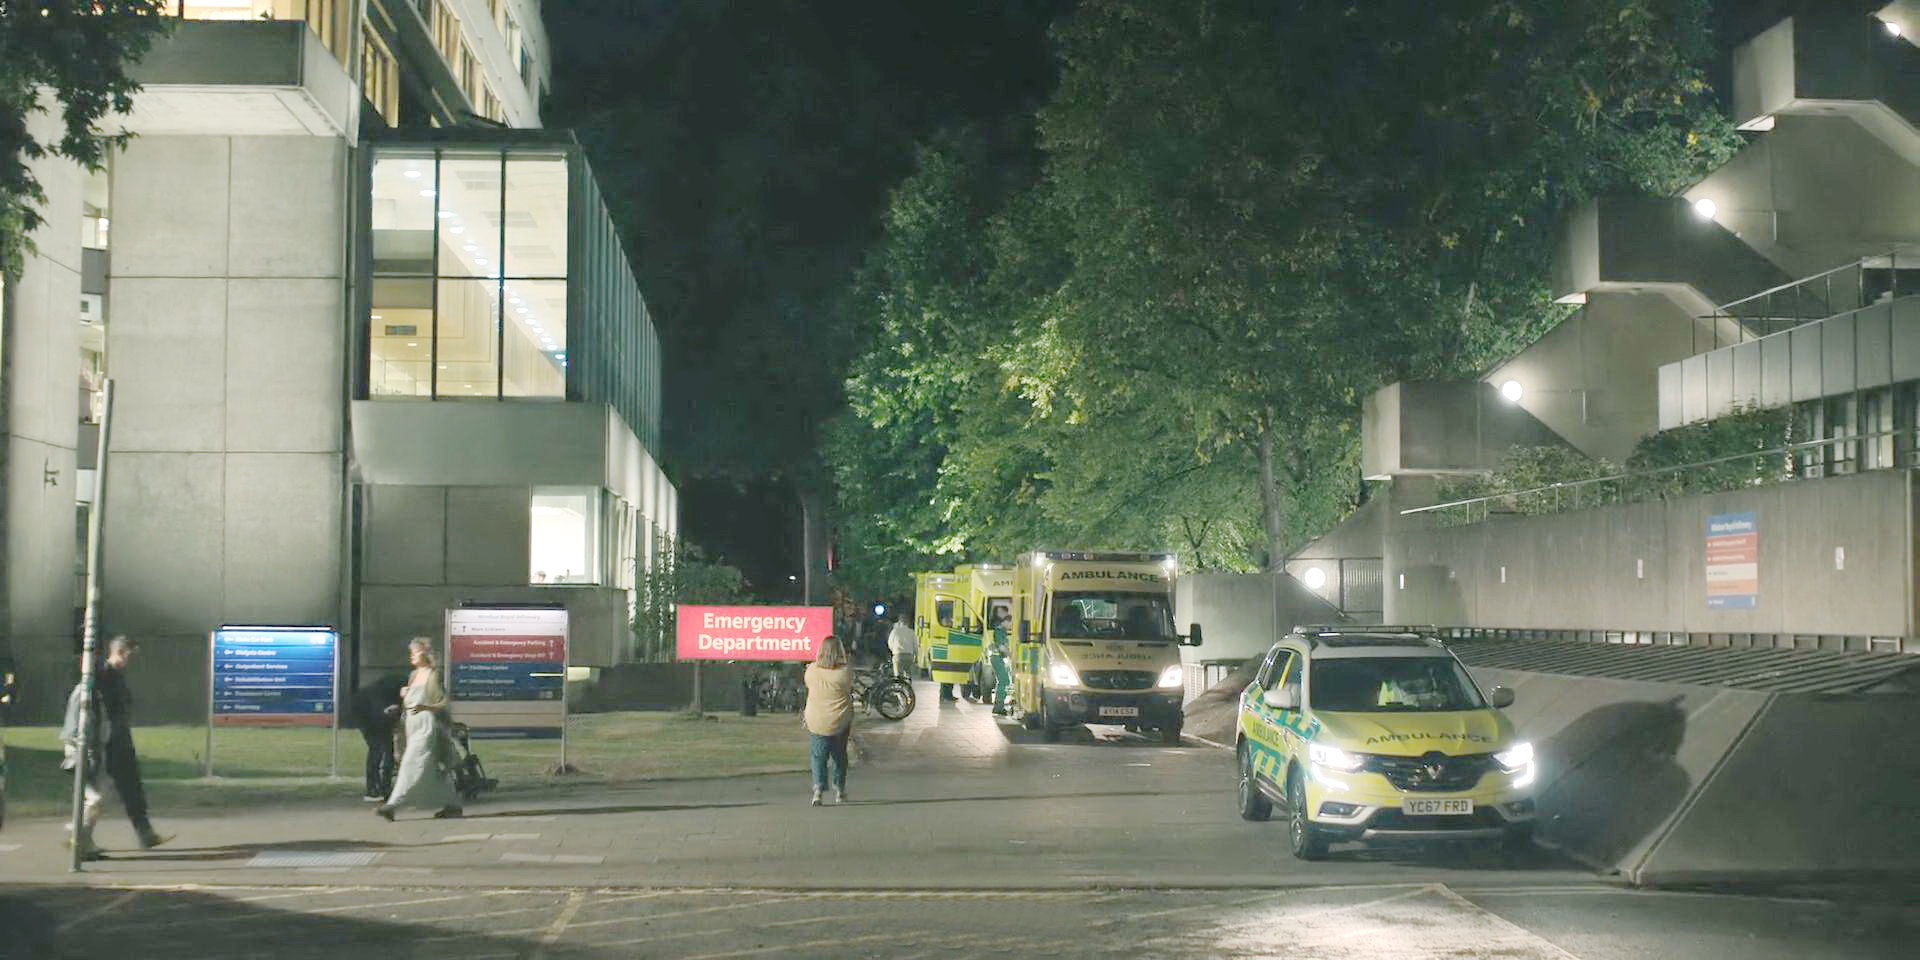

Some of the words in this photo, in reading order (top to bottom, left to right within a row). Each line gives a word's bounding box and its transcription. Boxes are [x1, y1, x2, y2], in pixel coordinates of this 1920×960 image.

[1061, 571, 1159, 583] AMBULANCE
[704, 612, 806, 633] Emergency
[698, 634, 811, 654] Department
[1252, 720, 1281, 748] AMBULANCE
[1365, 732, 1495, 745] AMBULANCE
[1409, 800, 1441, 813] YC67
[1443, 800, 1468, 813] FRD
